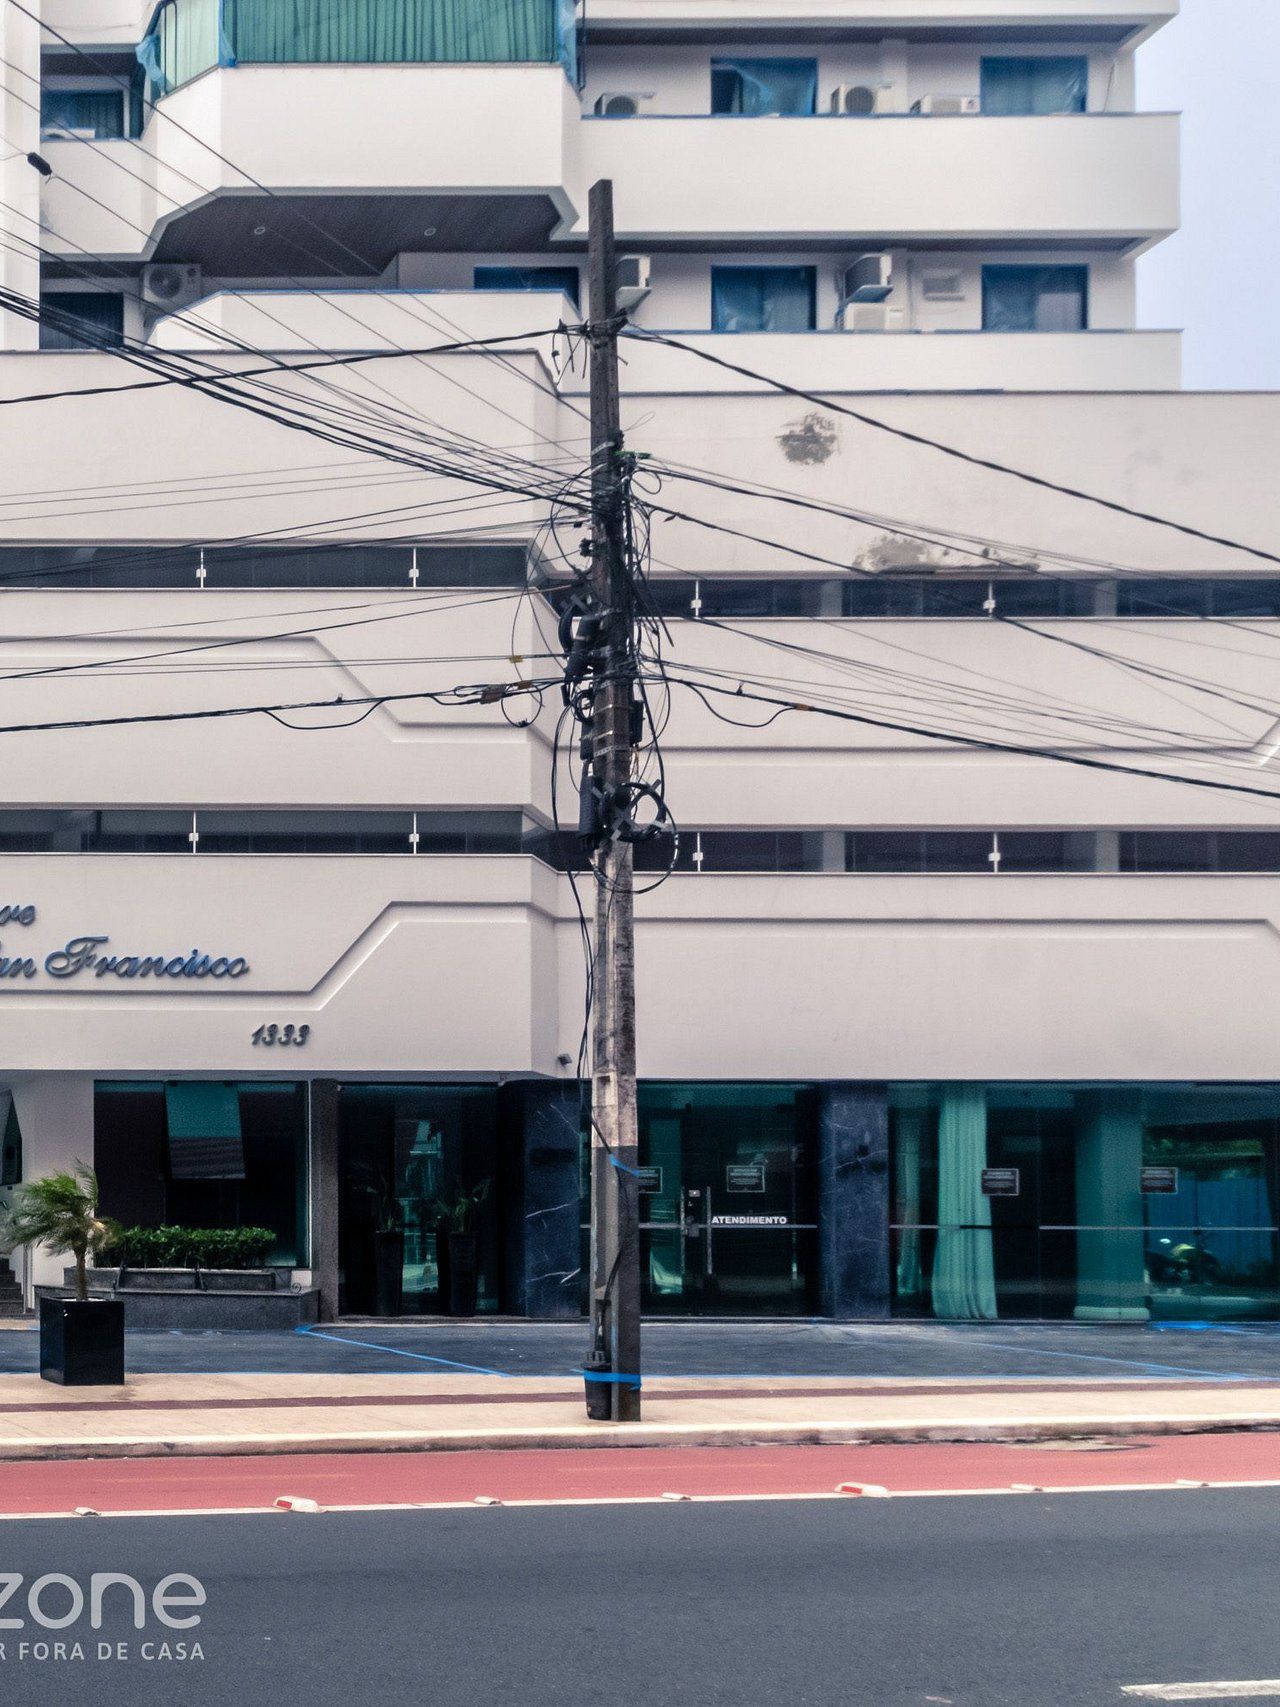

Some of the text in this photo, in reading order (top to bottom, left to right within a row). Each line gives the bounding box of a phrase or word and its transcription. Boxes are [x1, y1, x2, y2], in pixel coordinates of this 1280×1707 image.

[45, 936, 250, 978] Francisco
[251, 1023, 310, 1046] 1333
[711, 1216, 787, 1224] ATENDIMENTO
